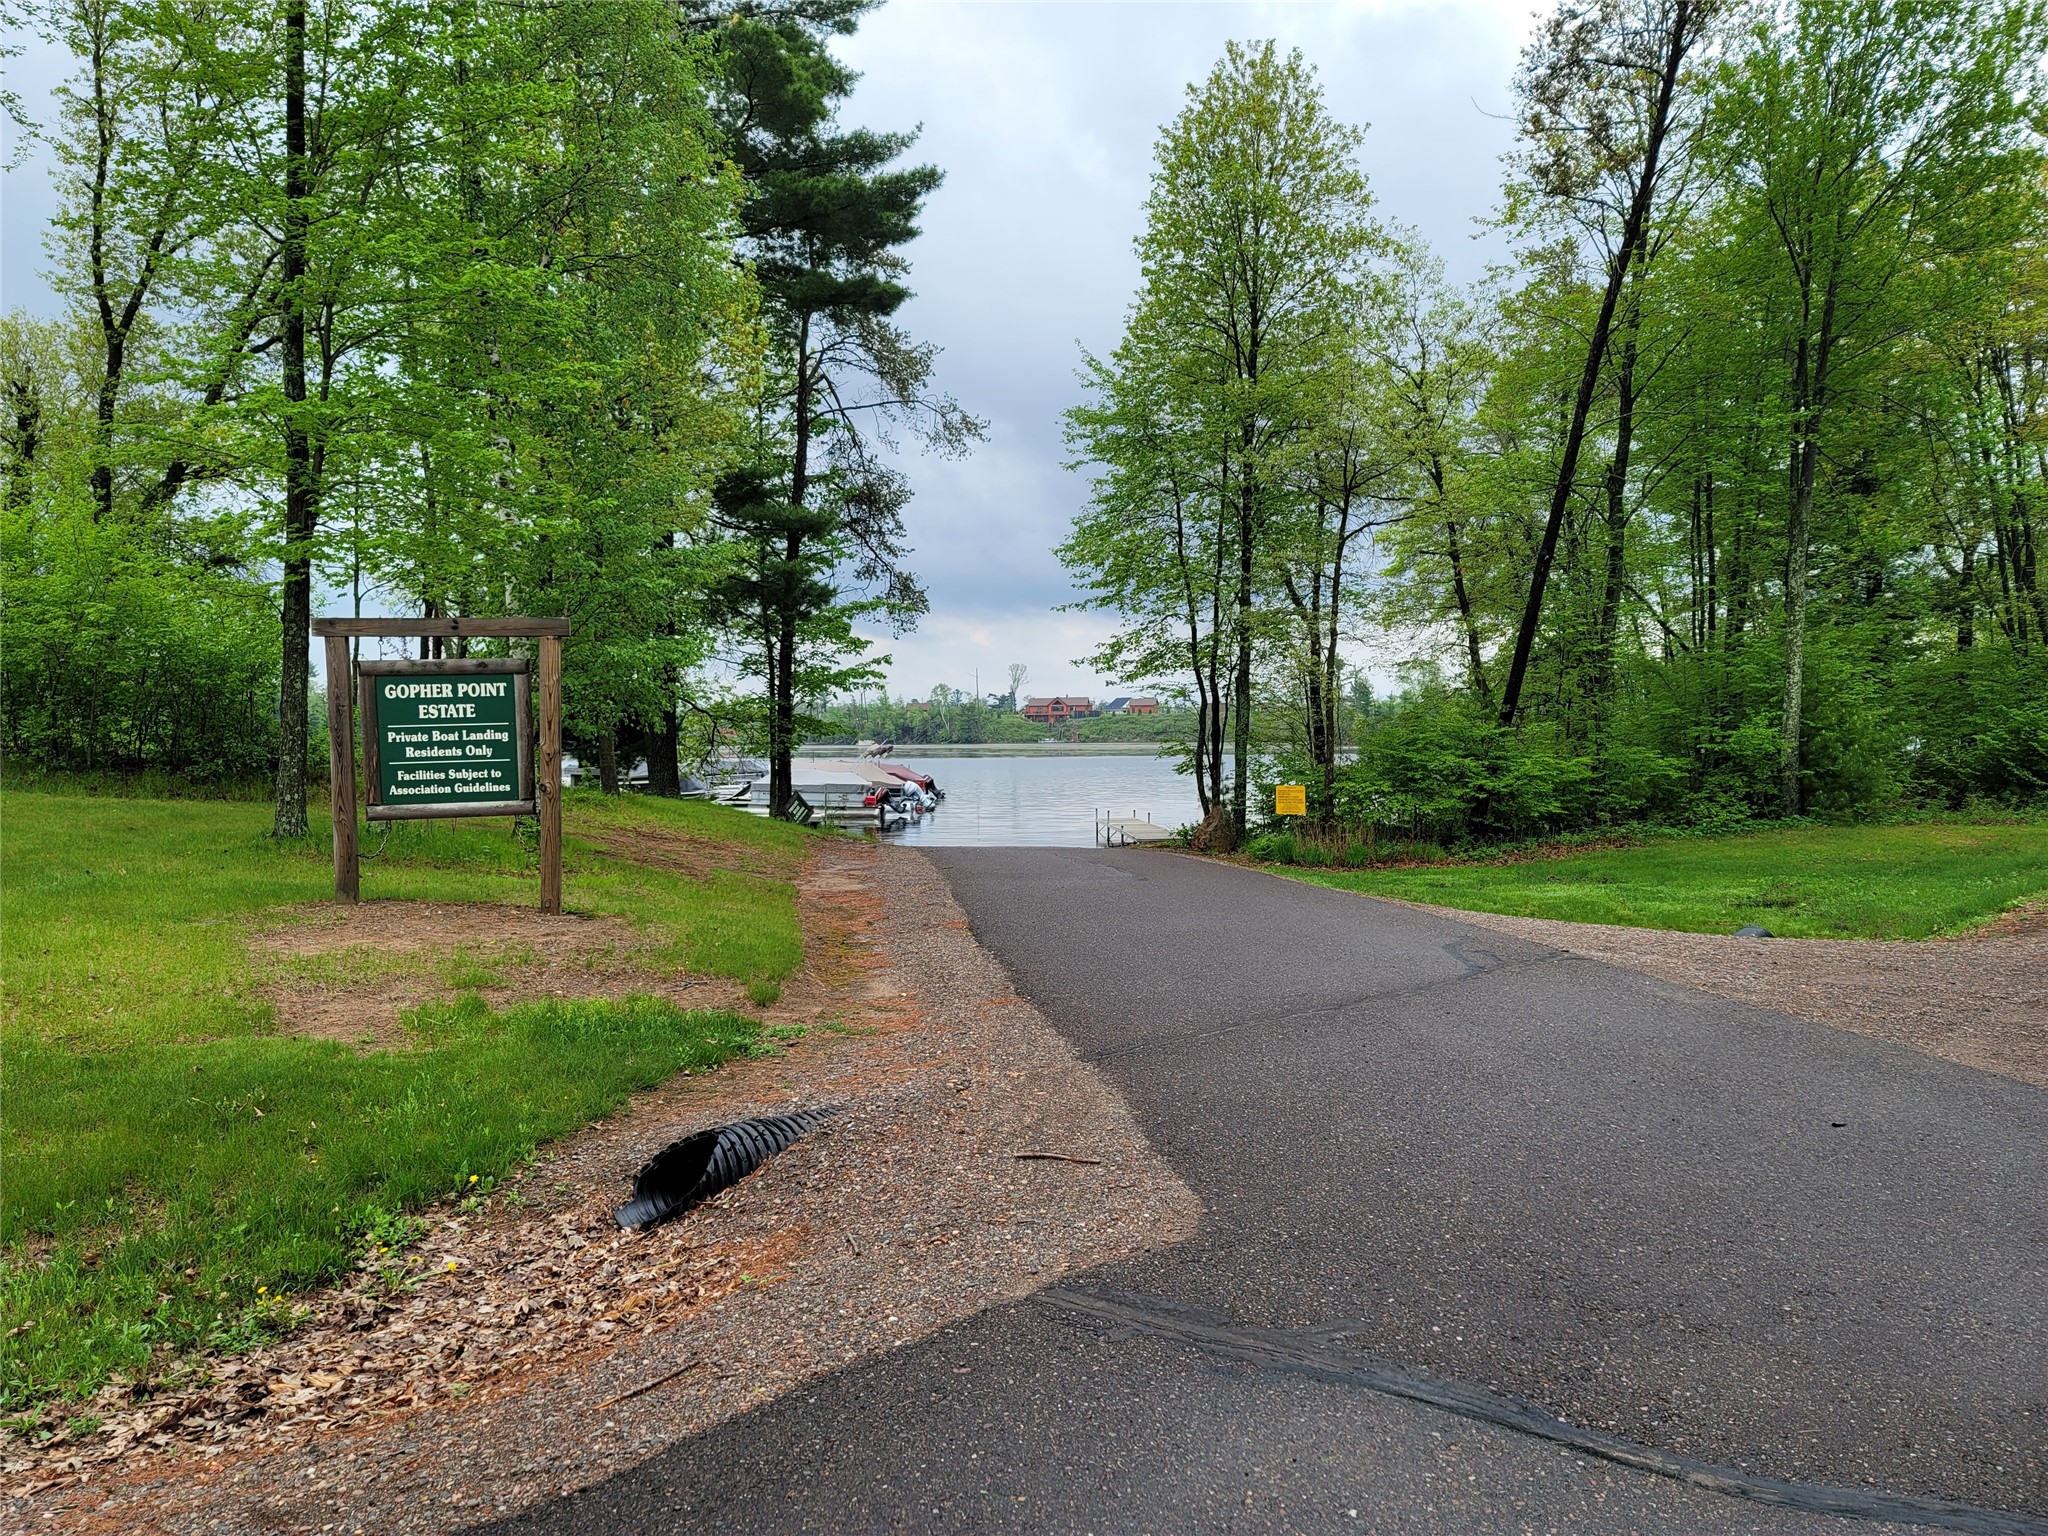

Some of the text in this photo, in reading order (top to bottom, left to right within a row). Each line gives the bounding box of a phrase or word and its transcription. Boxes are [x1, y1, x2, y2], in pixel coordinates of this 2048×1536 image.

[385, 683, 506, 699] GOPHER POINT
[419, 704, 476, 718] ESTATE
[388, 729, 509, 742] Private Boat Landing
[406, 745, 492, 758] Residents Only
[398, 769, 501, 780] Facilities Subject to
[390, 783, 510, 795] Association Guidelines
